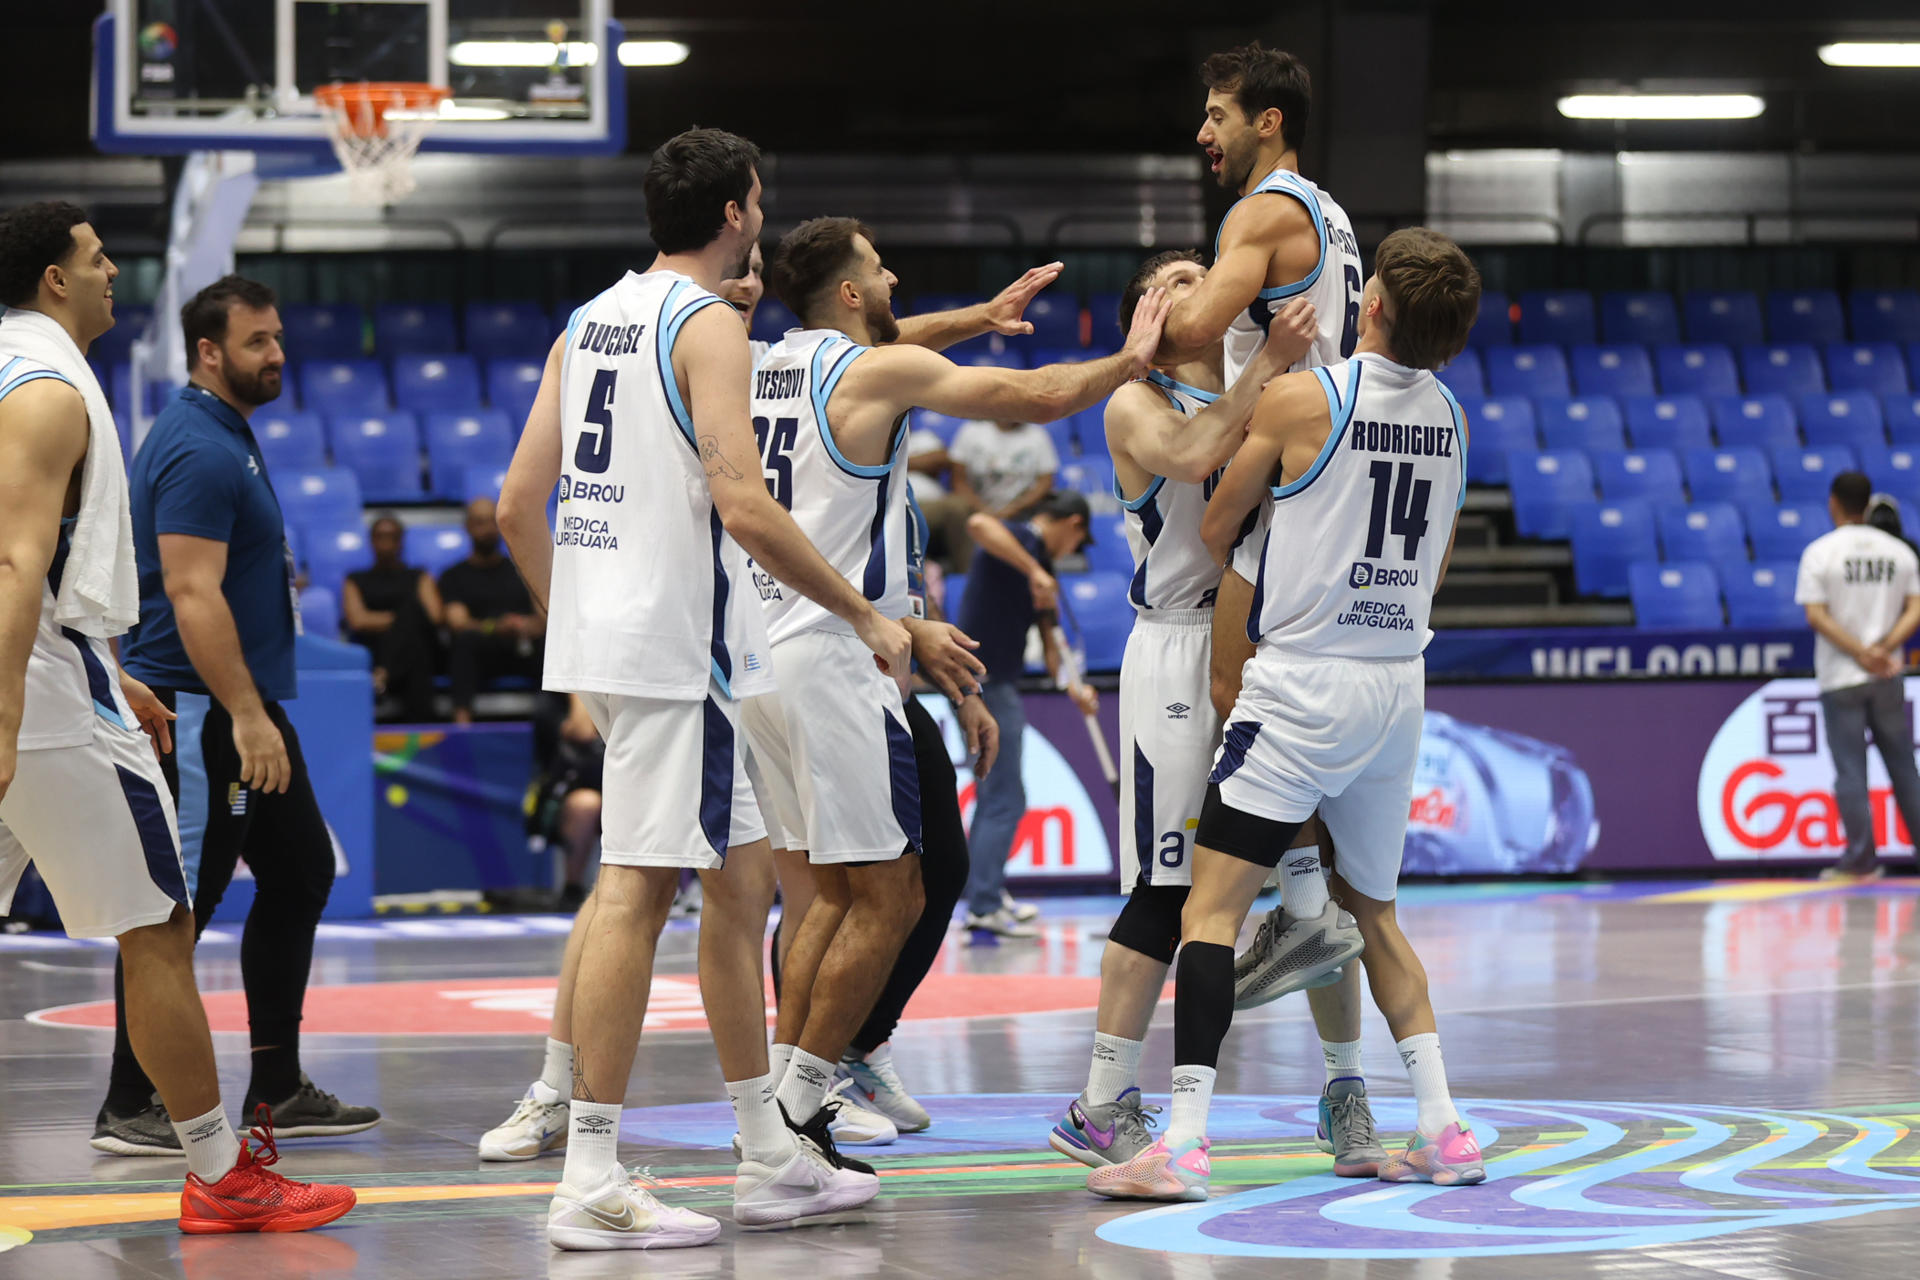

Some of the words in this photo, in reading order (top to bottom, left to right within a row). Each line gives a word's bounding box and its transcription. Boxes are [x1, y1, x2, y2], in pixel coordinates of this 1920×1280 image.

[579, 321, 646, 356] DUCASE
[755, 368, 805, 400] VESCOVI
[575, 369, 618, 474] 5
[1351, 420, 1453, 457] RODRIGUEZ
[573, 481, 624, 503] BROU
[1364, 460, 1432, 560] 14
[1374, 569, 1418, 586] BROU
[1844, 557, 1895, 584] STAFF
[1351, 600, 1406, 616] MEDICA
[1337, 613, 1414, 631] URUGUAYA
[1291, 866, 1319, 876] umbro
[797, 1073, 823, 1087] umbro
[191, 1126, 223, 1143] umbro
